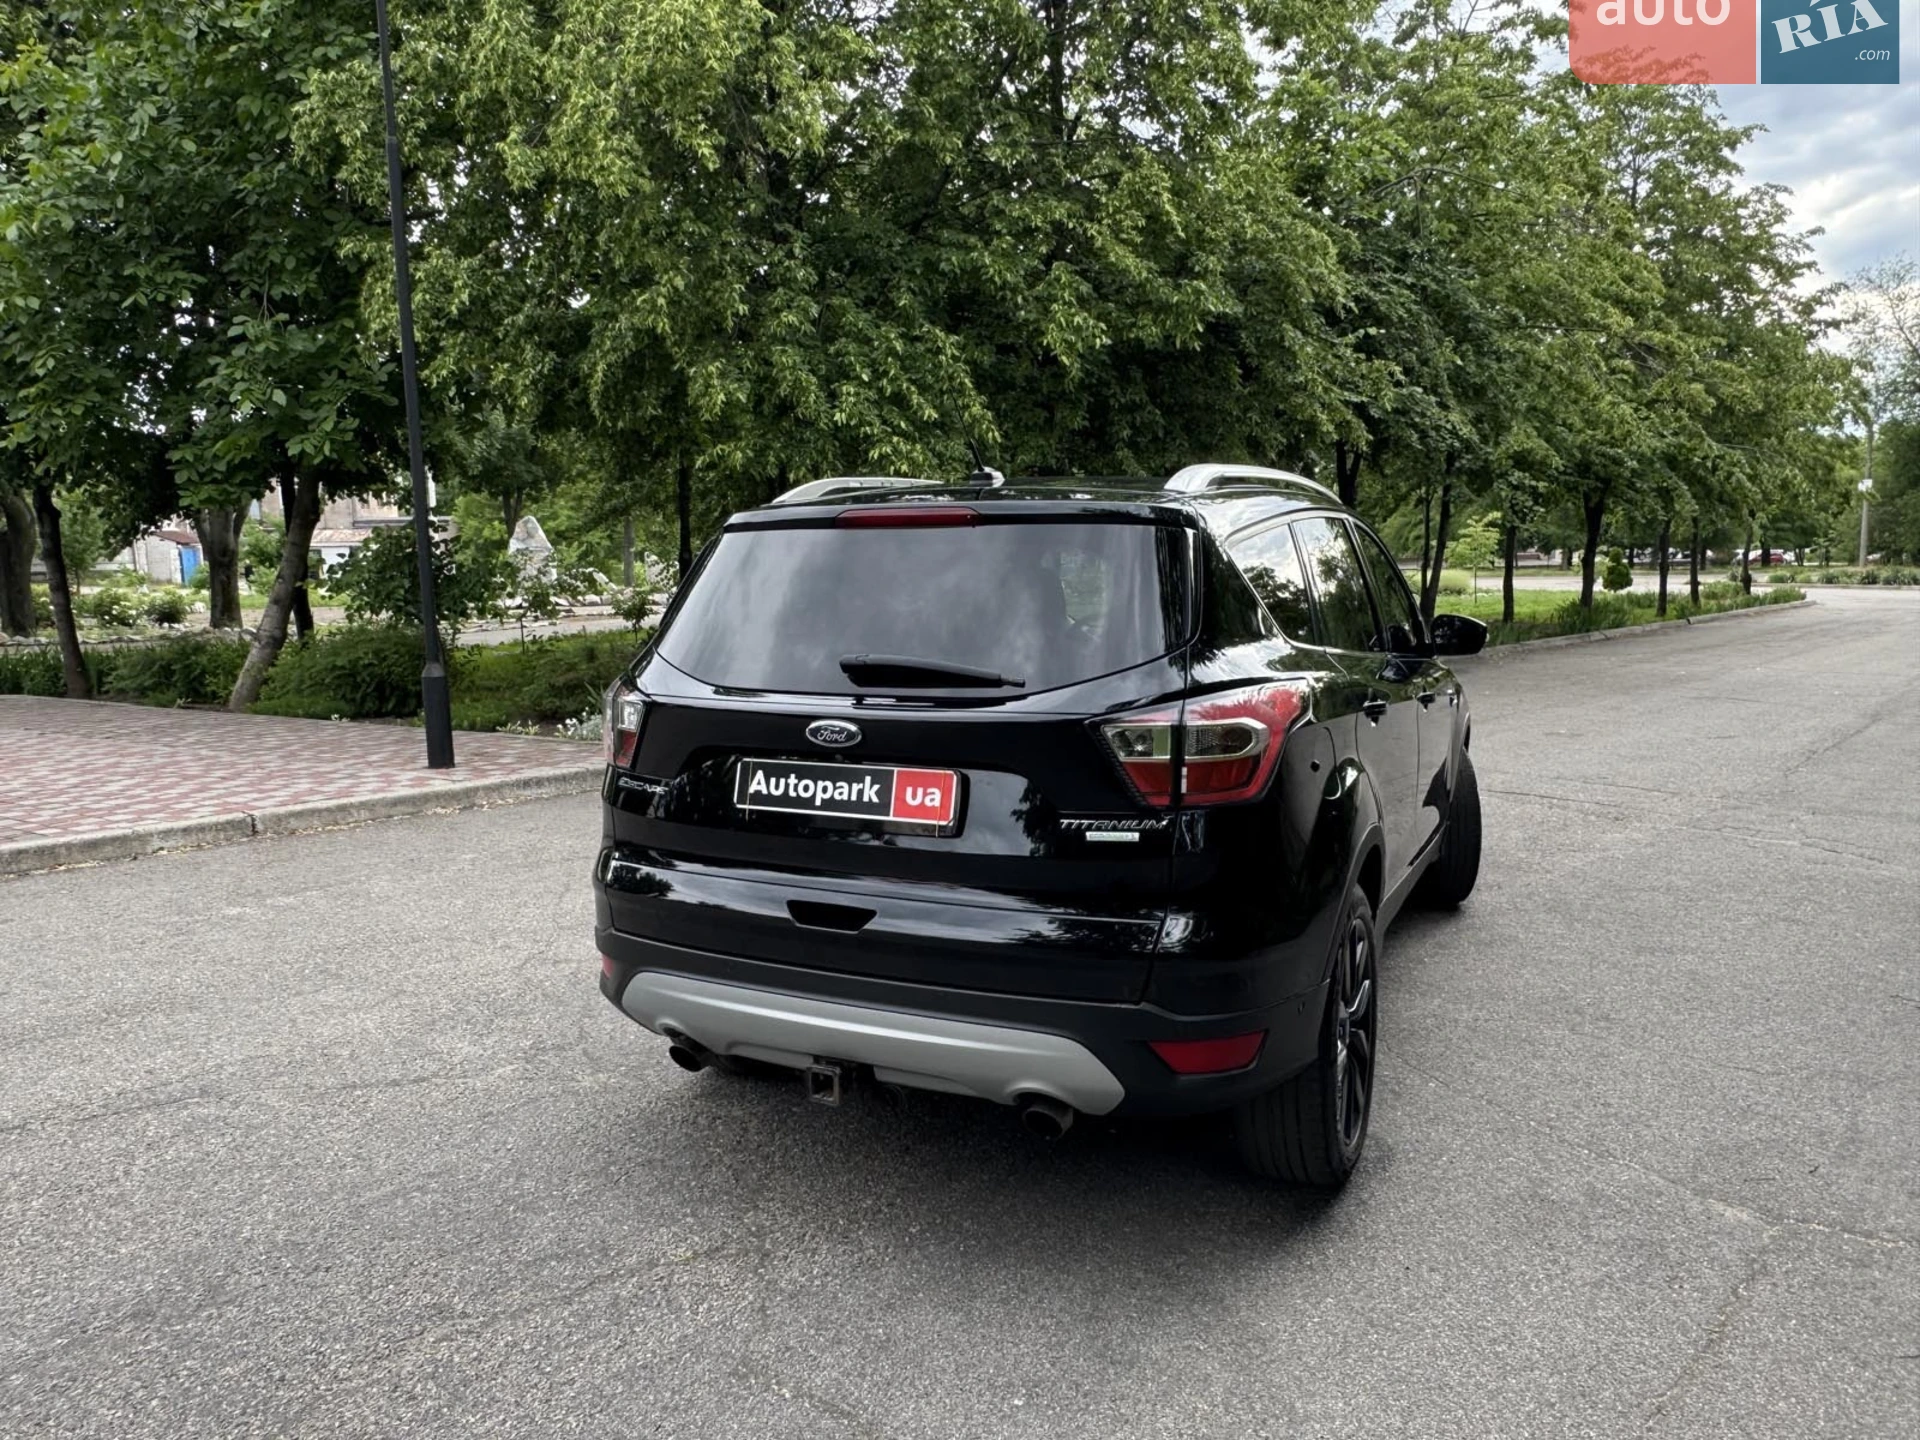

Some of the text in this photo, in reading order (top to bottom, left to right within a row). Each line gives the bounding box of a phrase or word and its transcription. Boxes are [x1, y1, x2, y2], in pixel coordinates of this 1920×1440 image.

[817, 725, 848, 742] Ford
[749, 769, 942, 807] Autopark ua
[1059, 818, 1167, 830] TITANIUM
